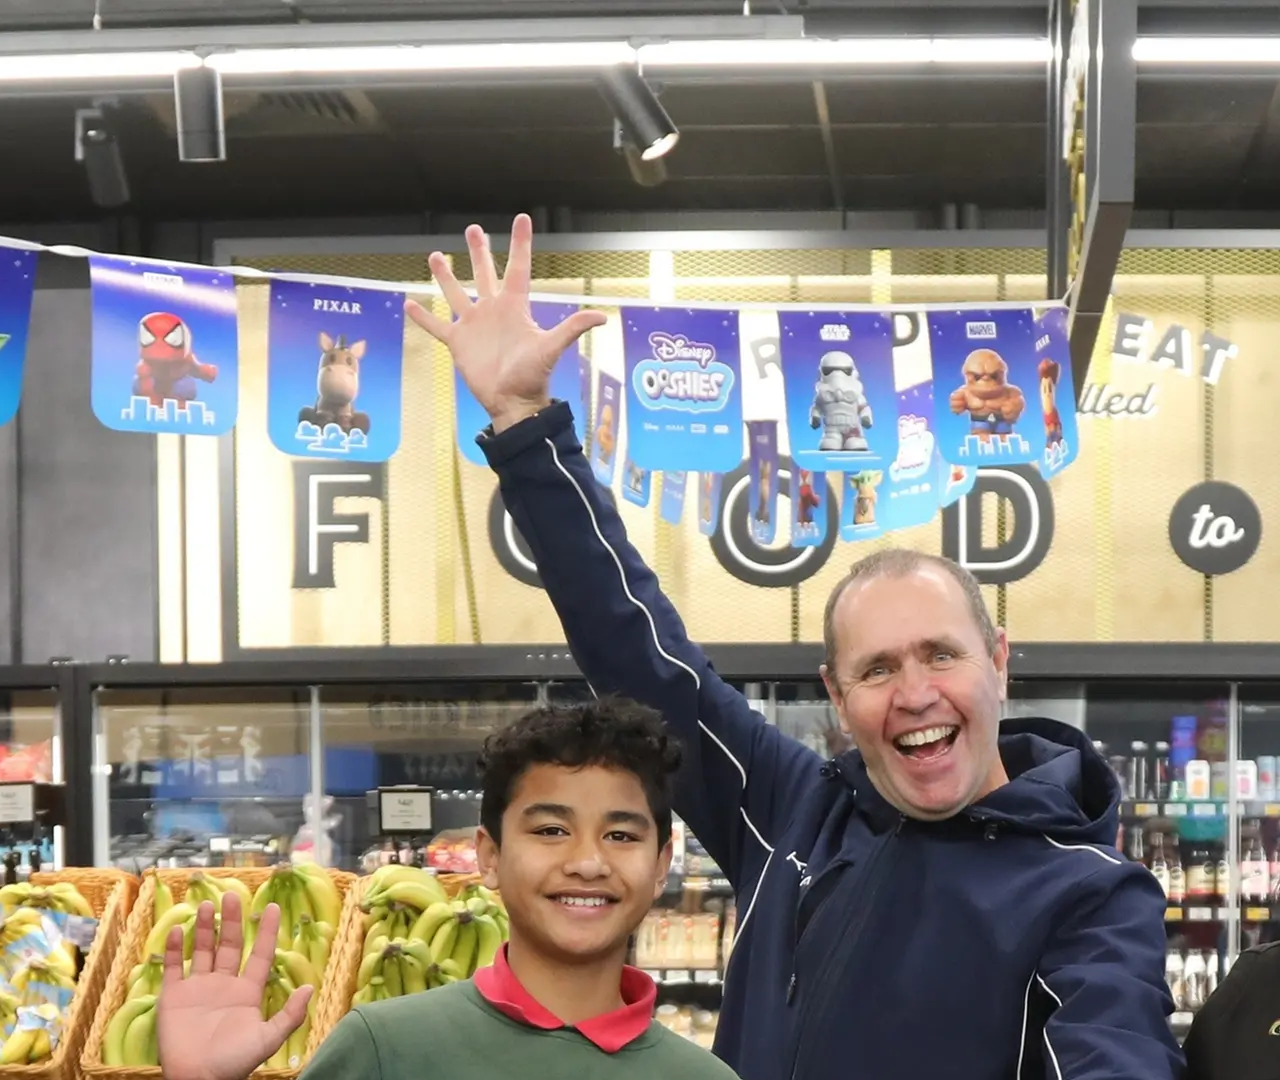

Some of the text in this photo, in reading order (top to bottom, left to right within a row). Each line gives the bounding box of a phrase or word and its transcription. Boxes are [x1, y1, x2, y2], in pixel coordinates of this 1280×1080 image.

[313, 298, 362, 316] PIXAR
[968, 323, 996, 337] MARVEL
[1113, 312, 1240, 378] EAT
[653, 335, 713, 364] Disney
[1078, 383, 1155, 415] lled
[1188, 504, 1246, 549] to
